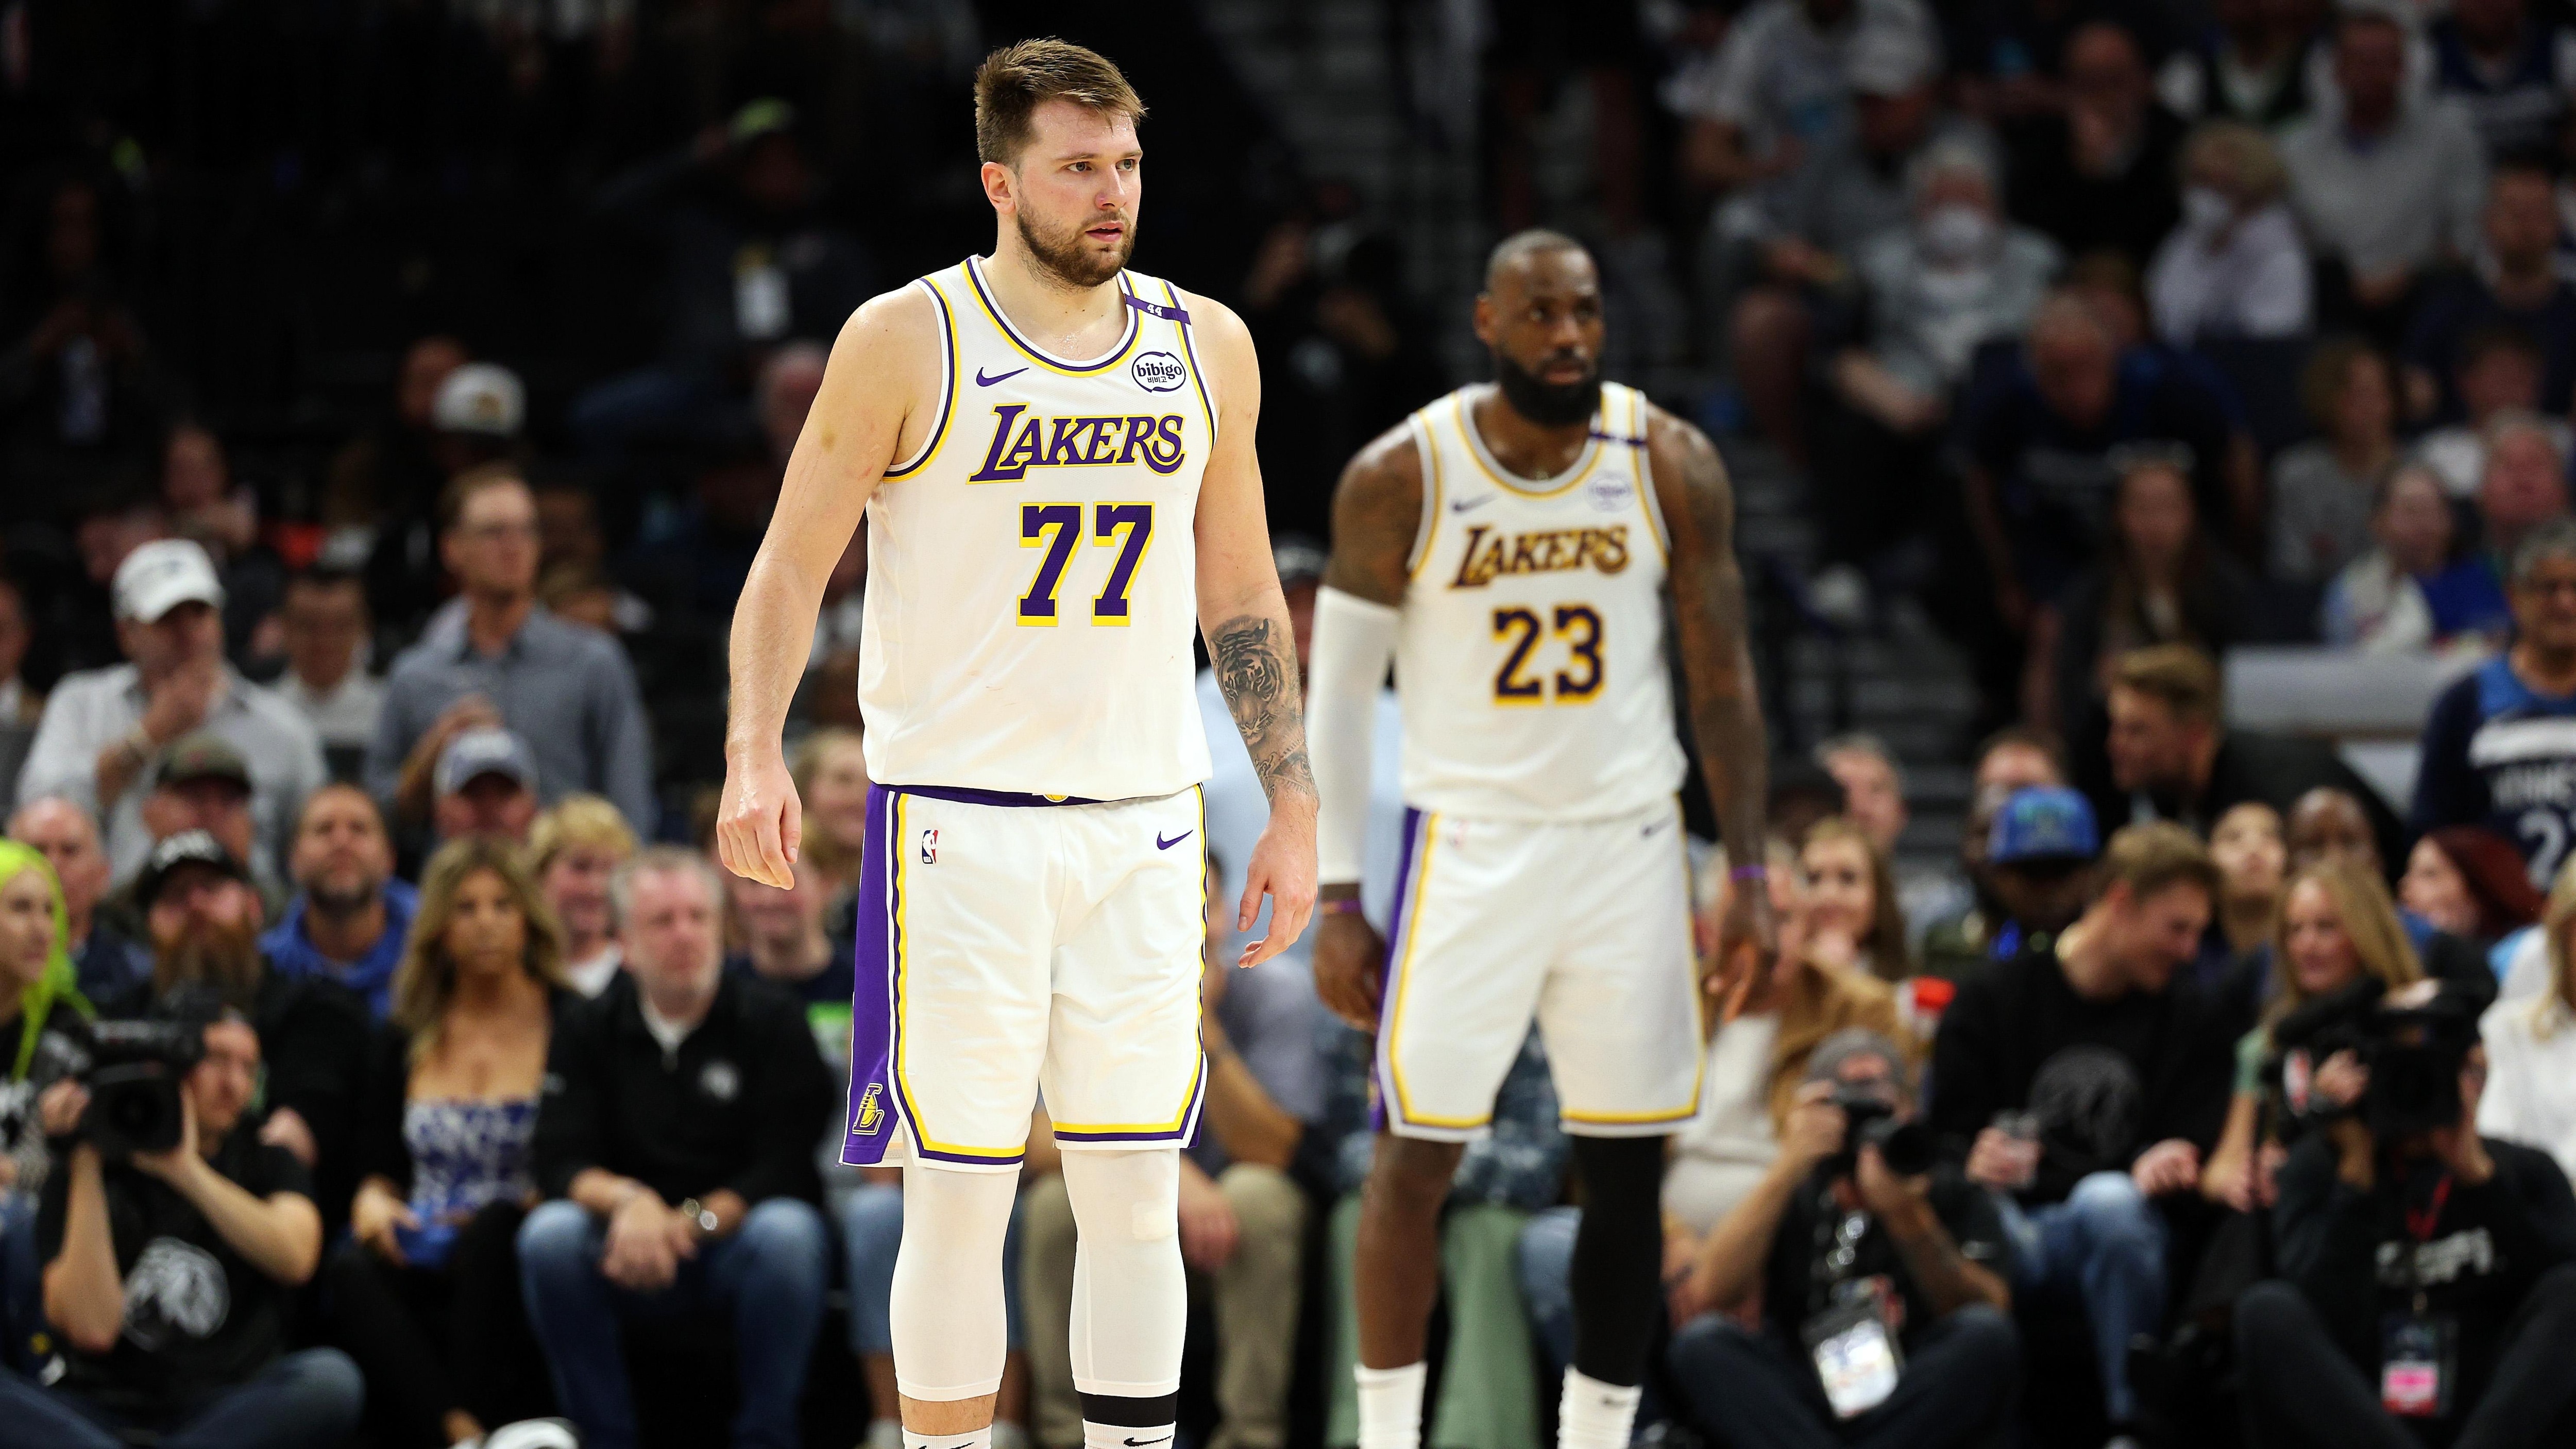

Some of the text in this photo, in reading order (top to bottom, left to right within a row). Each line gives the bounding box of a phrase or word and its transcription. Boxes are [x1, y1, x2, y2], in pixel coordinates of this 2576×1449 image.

[1147, 304, 1162, 317] 44
[1136, 362, 1182, 380] bibigo
[966, 402, 1187, 485] LAKERS
[1016, 502, 1155, 627] 77
[1447, 523, 1631, 591] LAKERS
[1492, 603, 1606, 707] 23
